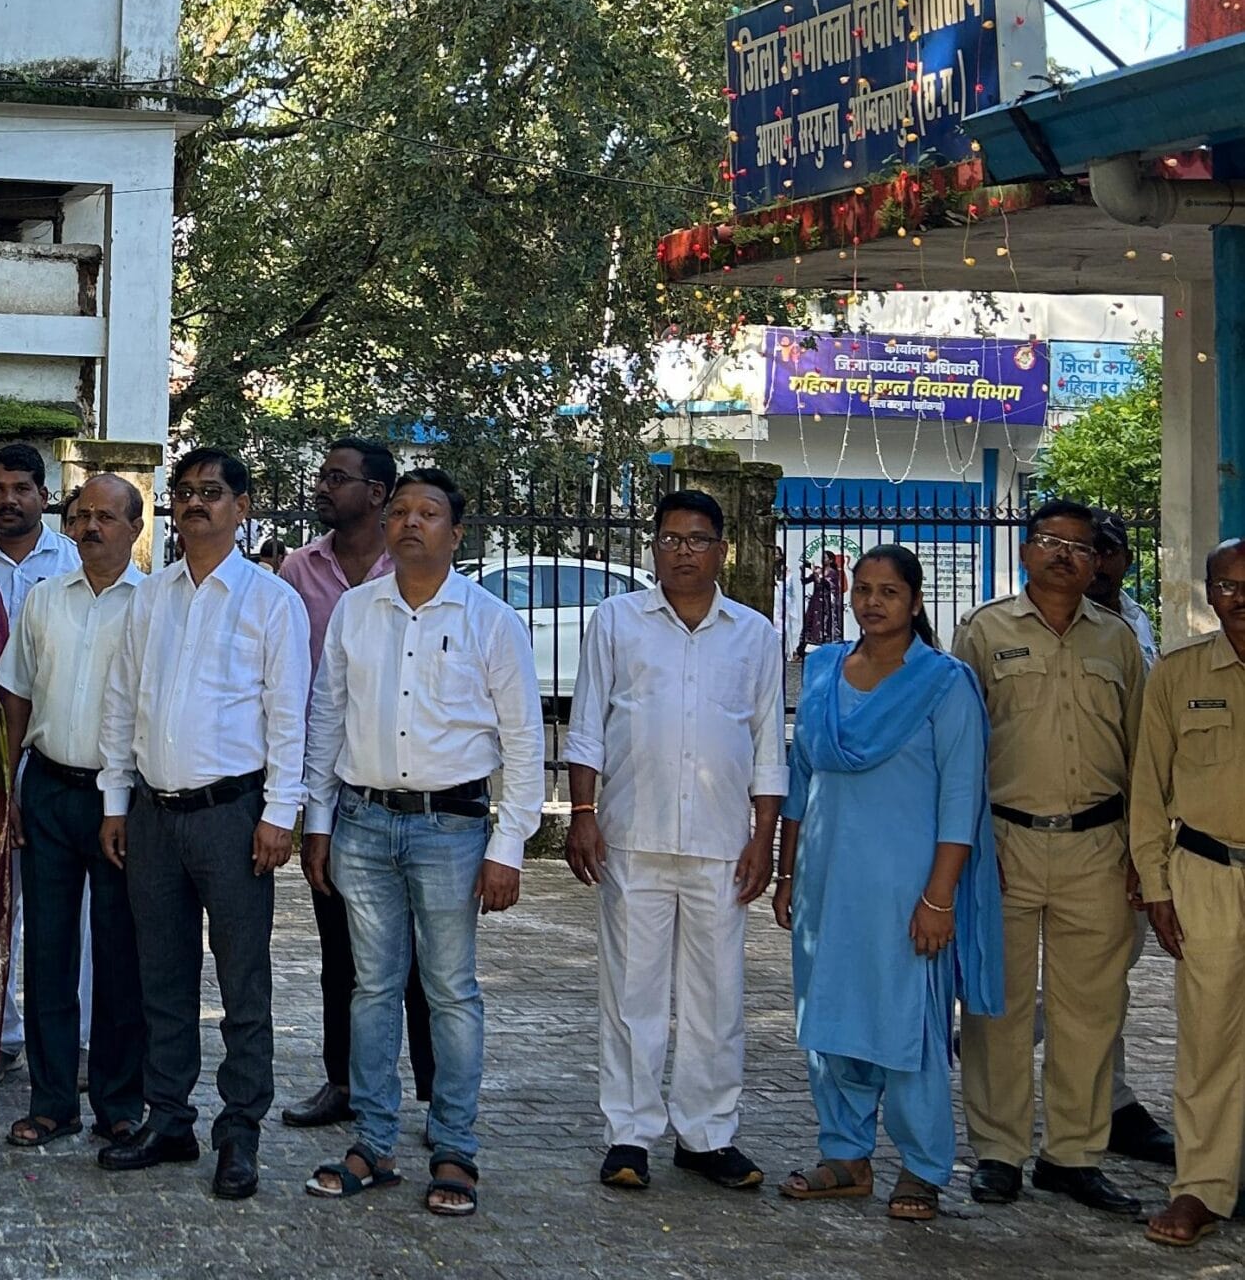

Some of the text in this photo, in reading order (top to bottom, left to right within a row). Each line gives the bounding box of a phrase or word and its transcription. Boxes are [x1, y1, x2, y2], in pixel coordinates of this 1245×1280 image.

[738, 27, 780, 97] जिला
[885, 341, 931, 355] कार्यालय
[834, 355, 980, 376] जिला कार्यक्रम अधिकारी
[1059, 353, 1100, 375] जिला
[789, 371, 1023, 402] महिला एवं बाल विकास विभाग
